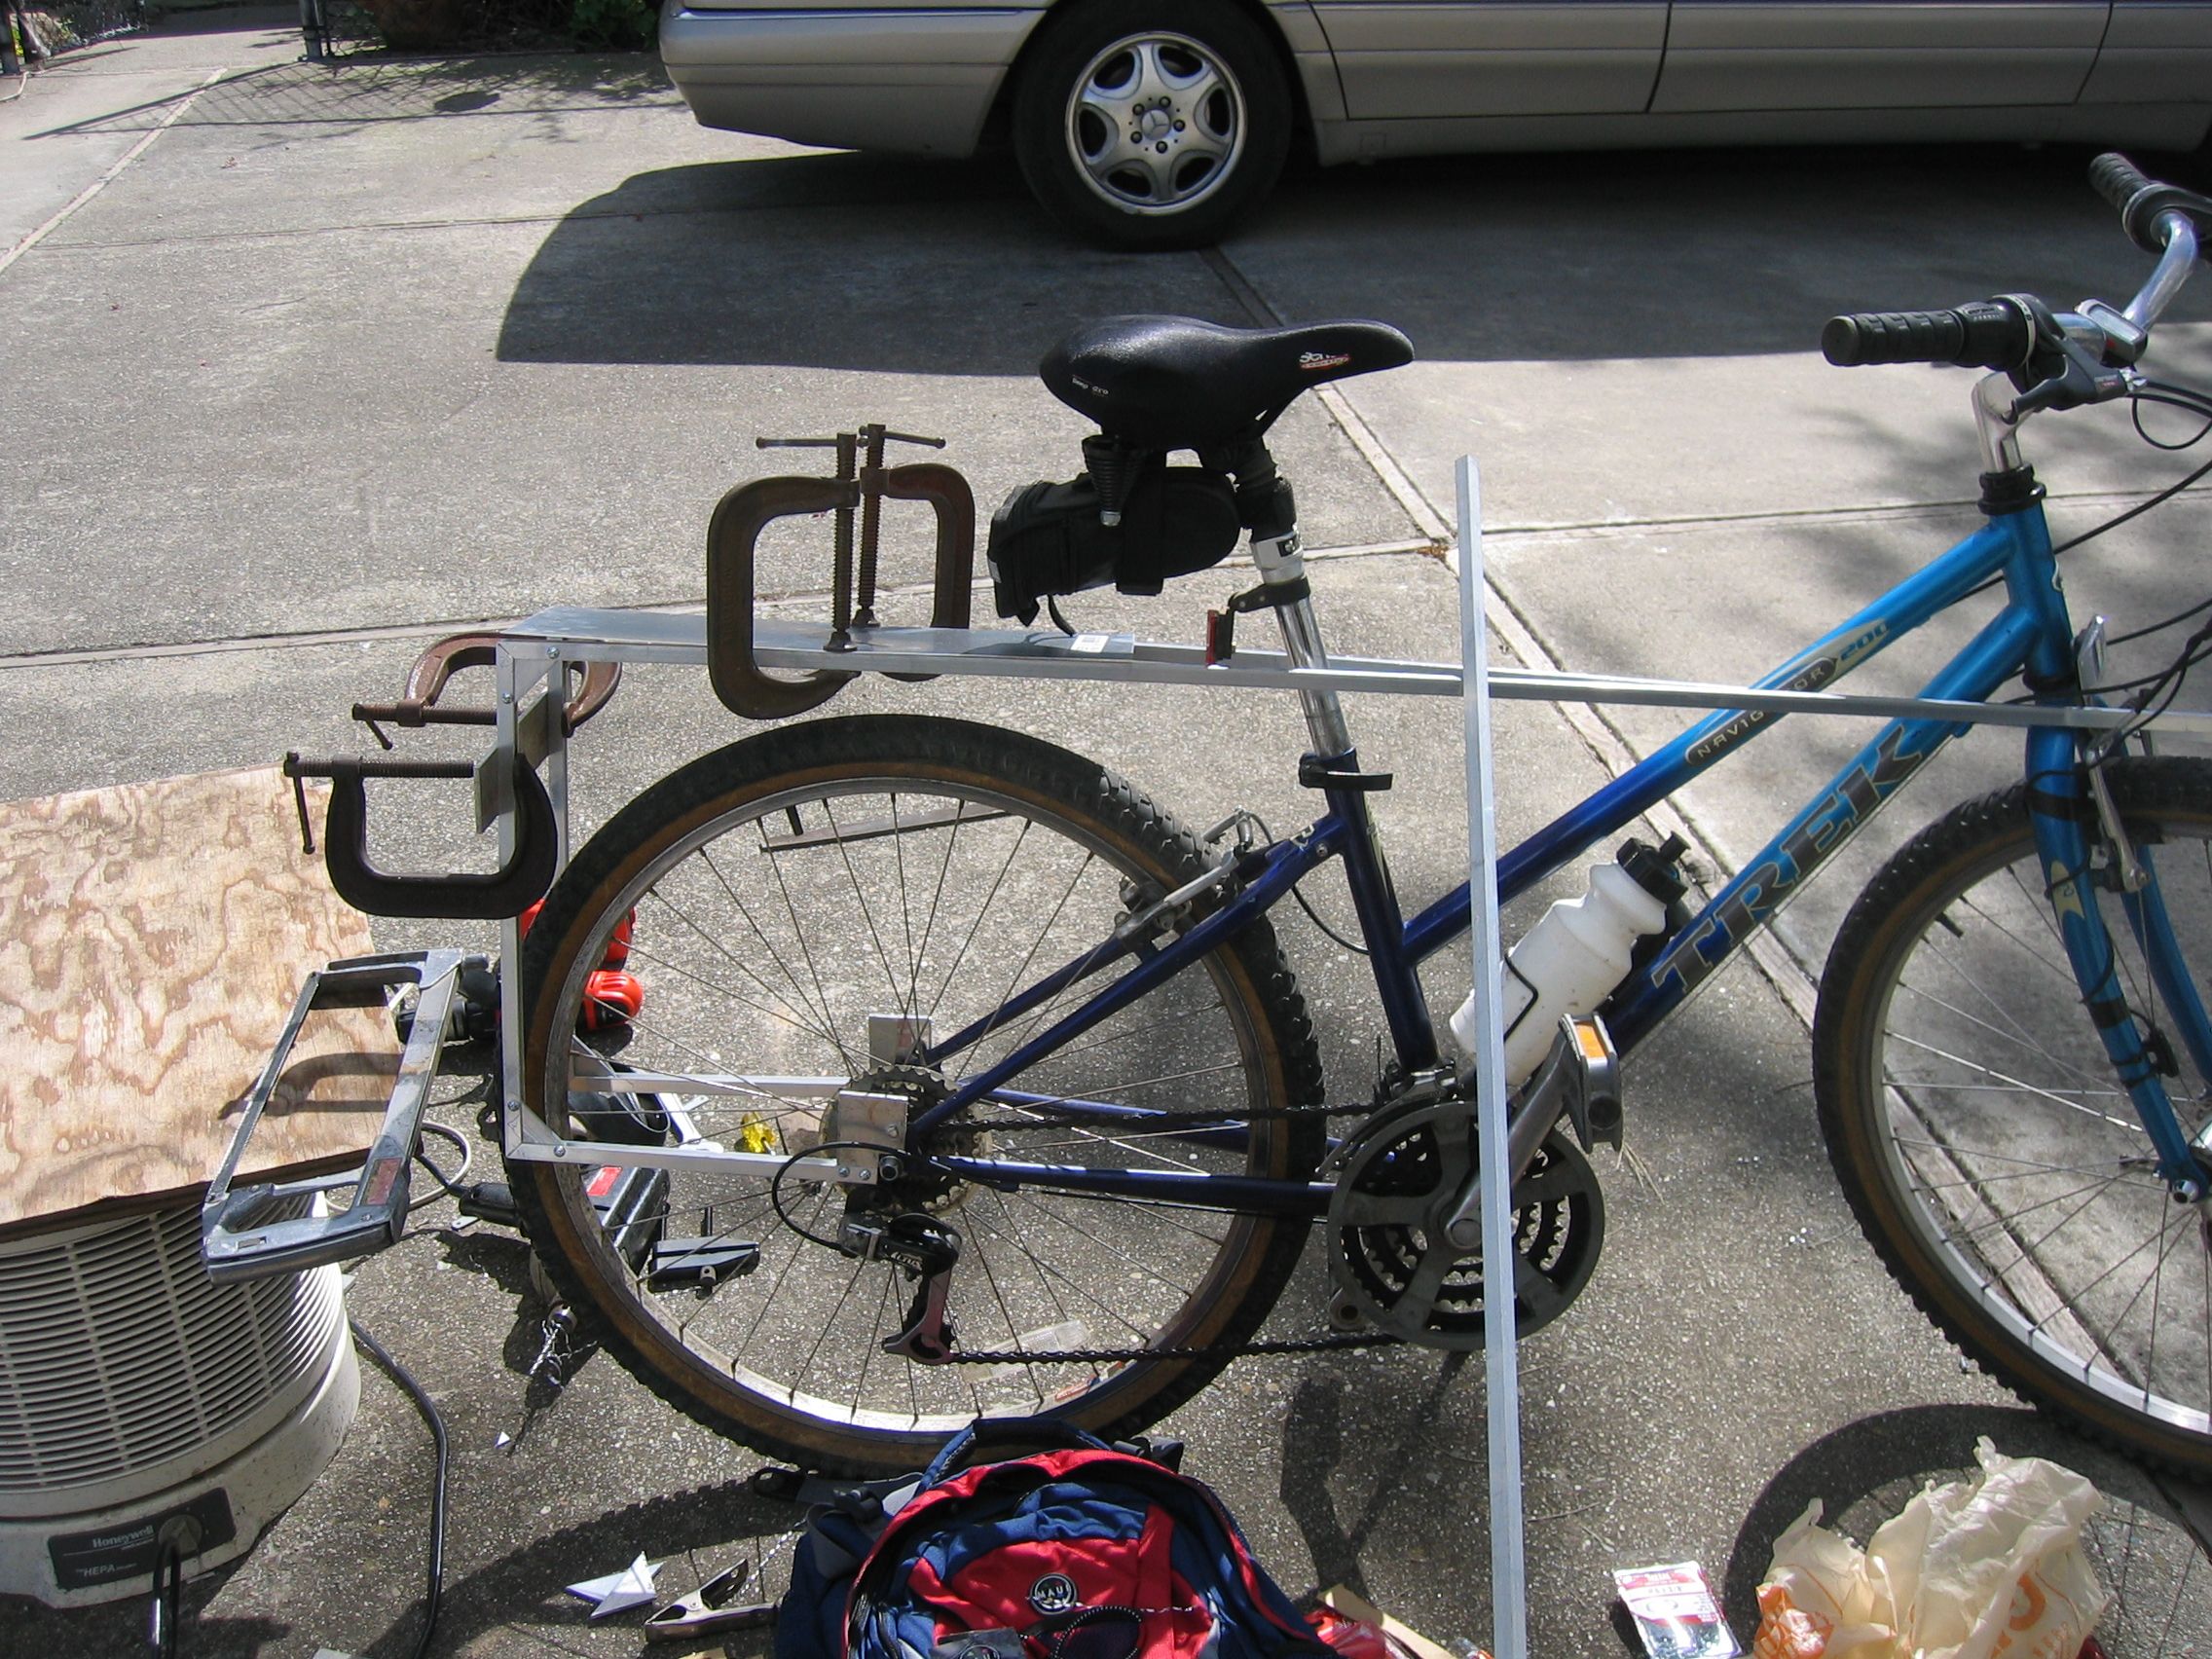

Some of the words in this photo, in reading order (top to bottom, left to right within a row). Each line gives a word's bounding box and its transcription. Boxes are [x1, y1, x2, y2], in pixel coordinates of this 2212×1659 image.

[1697, 667, 1825, 758] NAVIGOR
[1651, 724, 1923, 994] TREK
[92, 1525, 154, 1548] Honeywell
